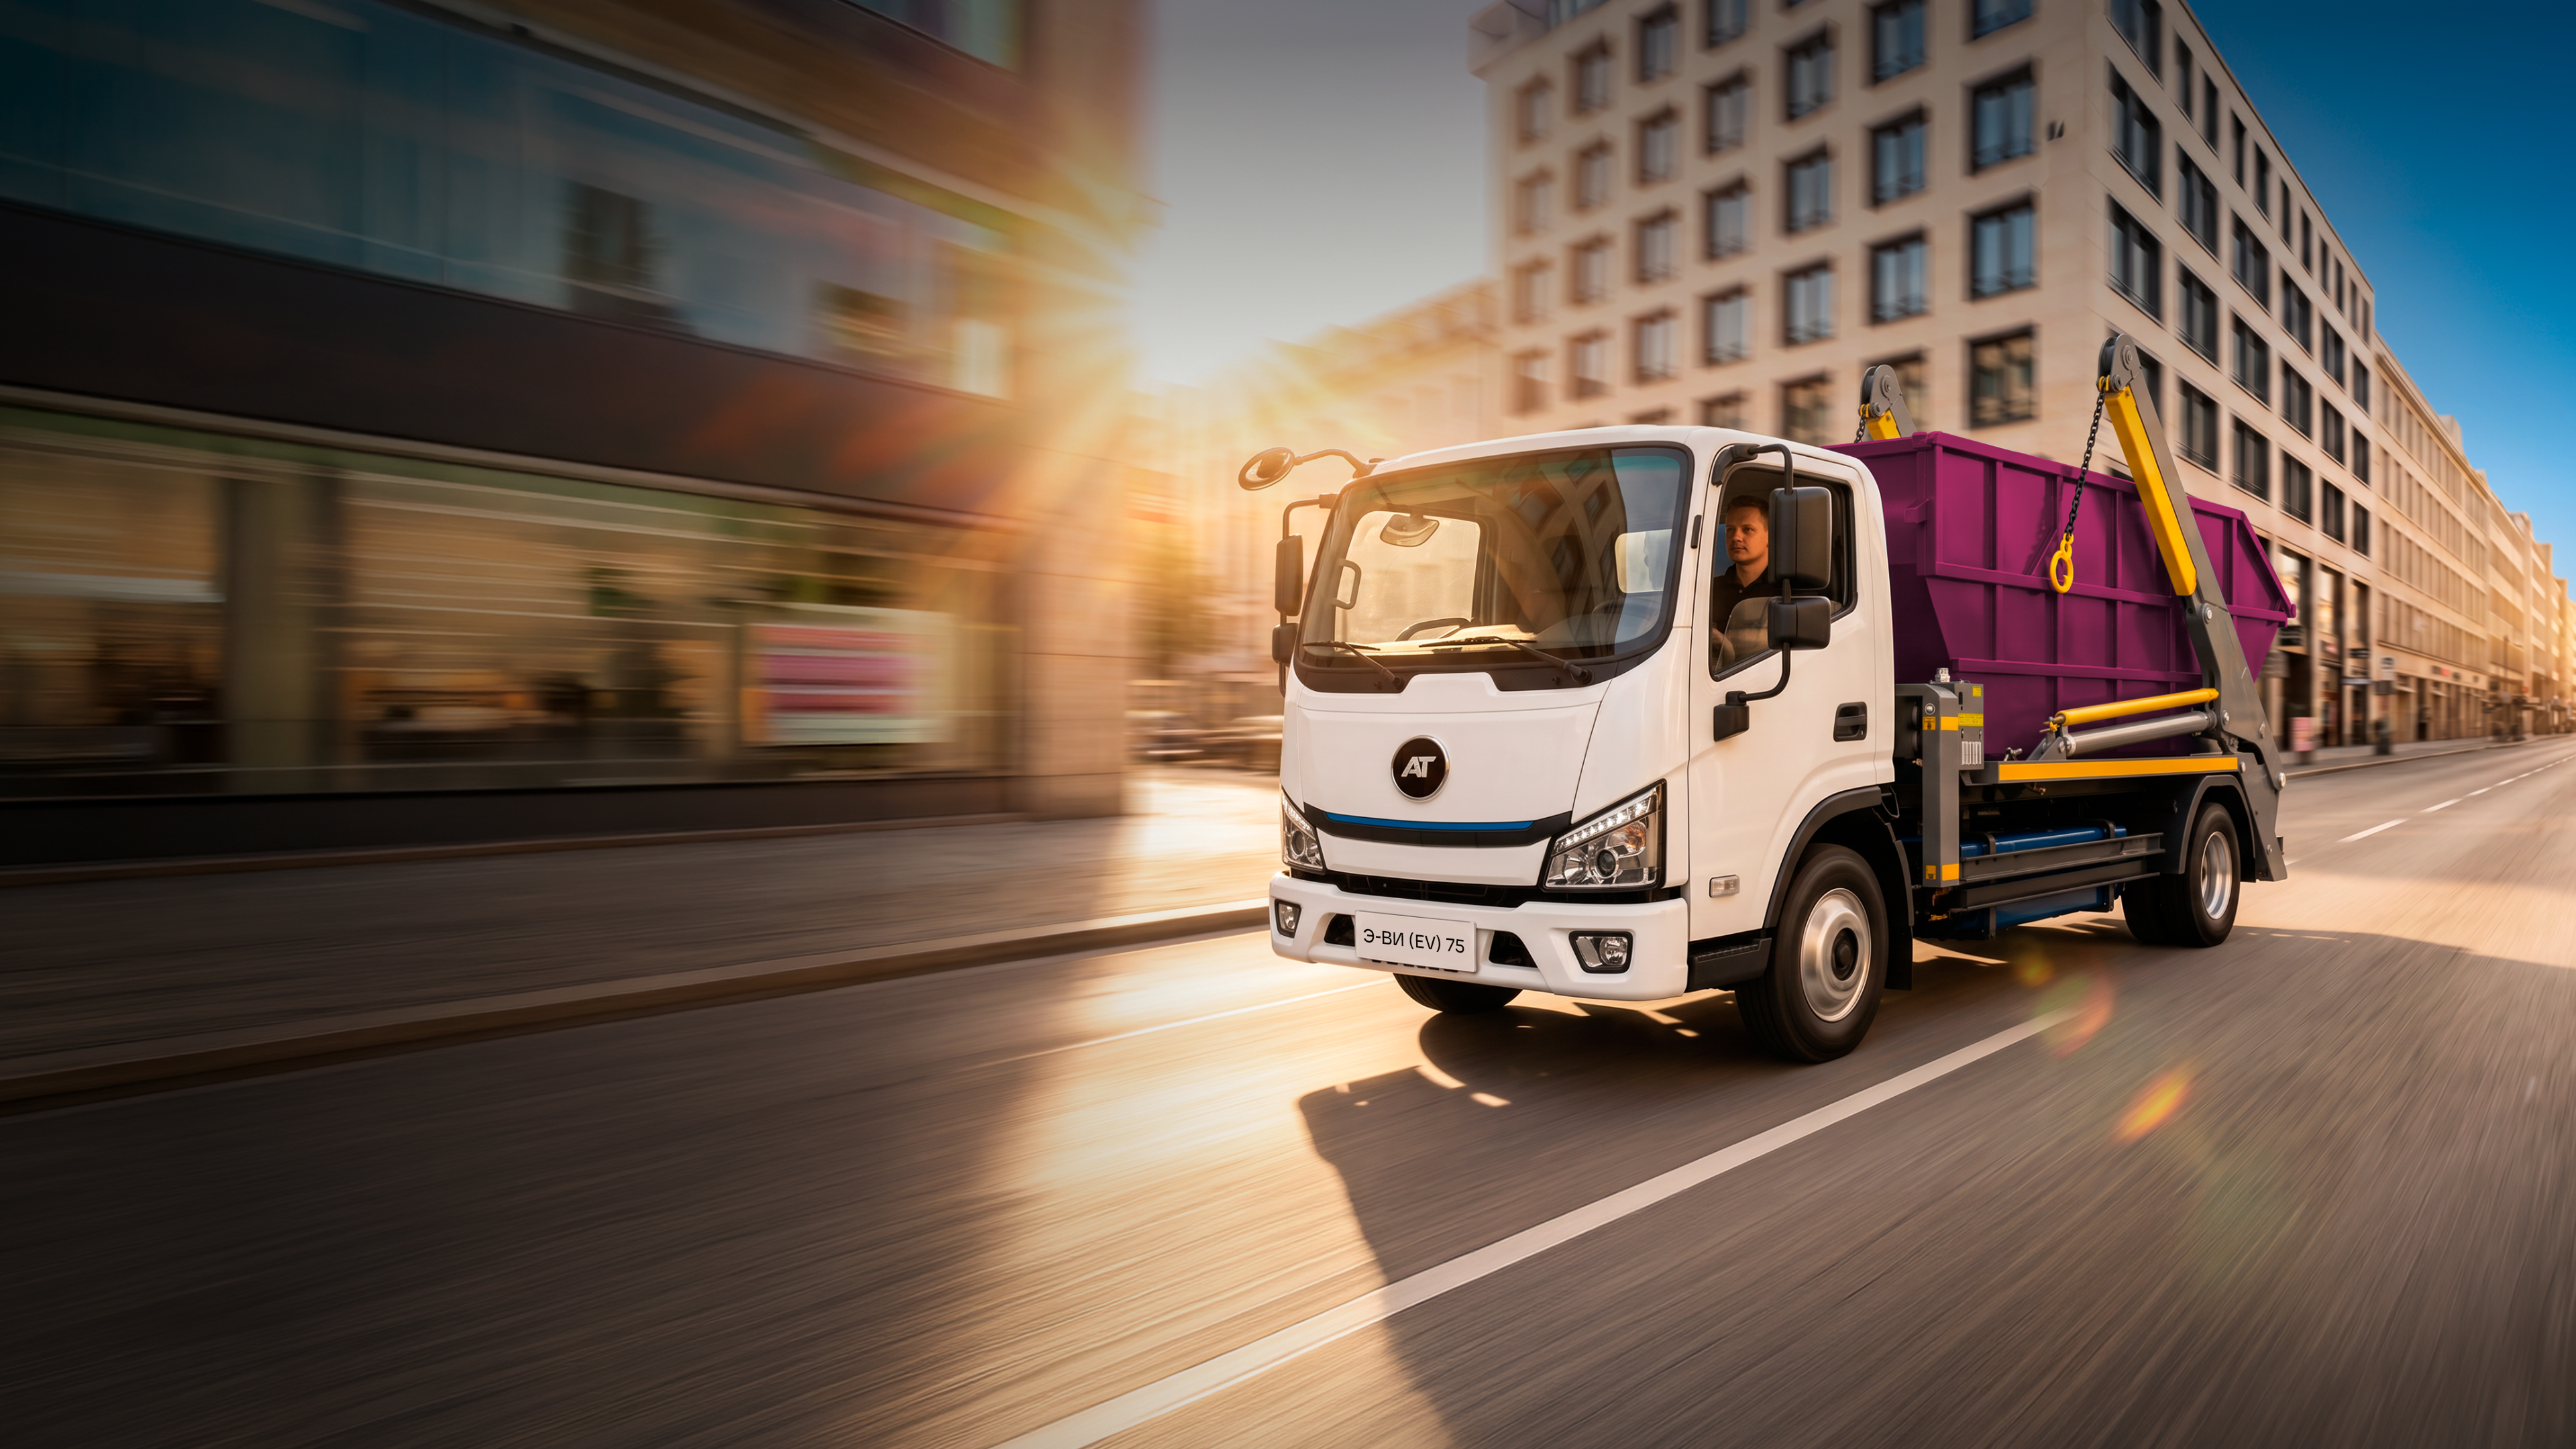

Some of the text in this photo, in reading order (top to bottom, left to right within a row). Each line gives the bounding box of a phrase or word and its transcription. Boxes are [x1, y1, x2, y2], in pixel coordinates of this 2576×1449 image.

[1401, 756, 1437, 778] AT
[1363, 928, 1465, 953] Э-ВИ (EV) 75
